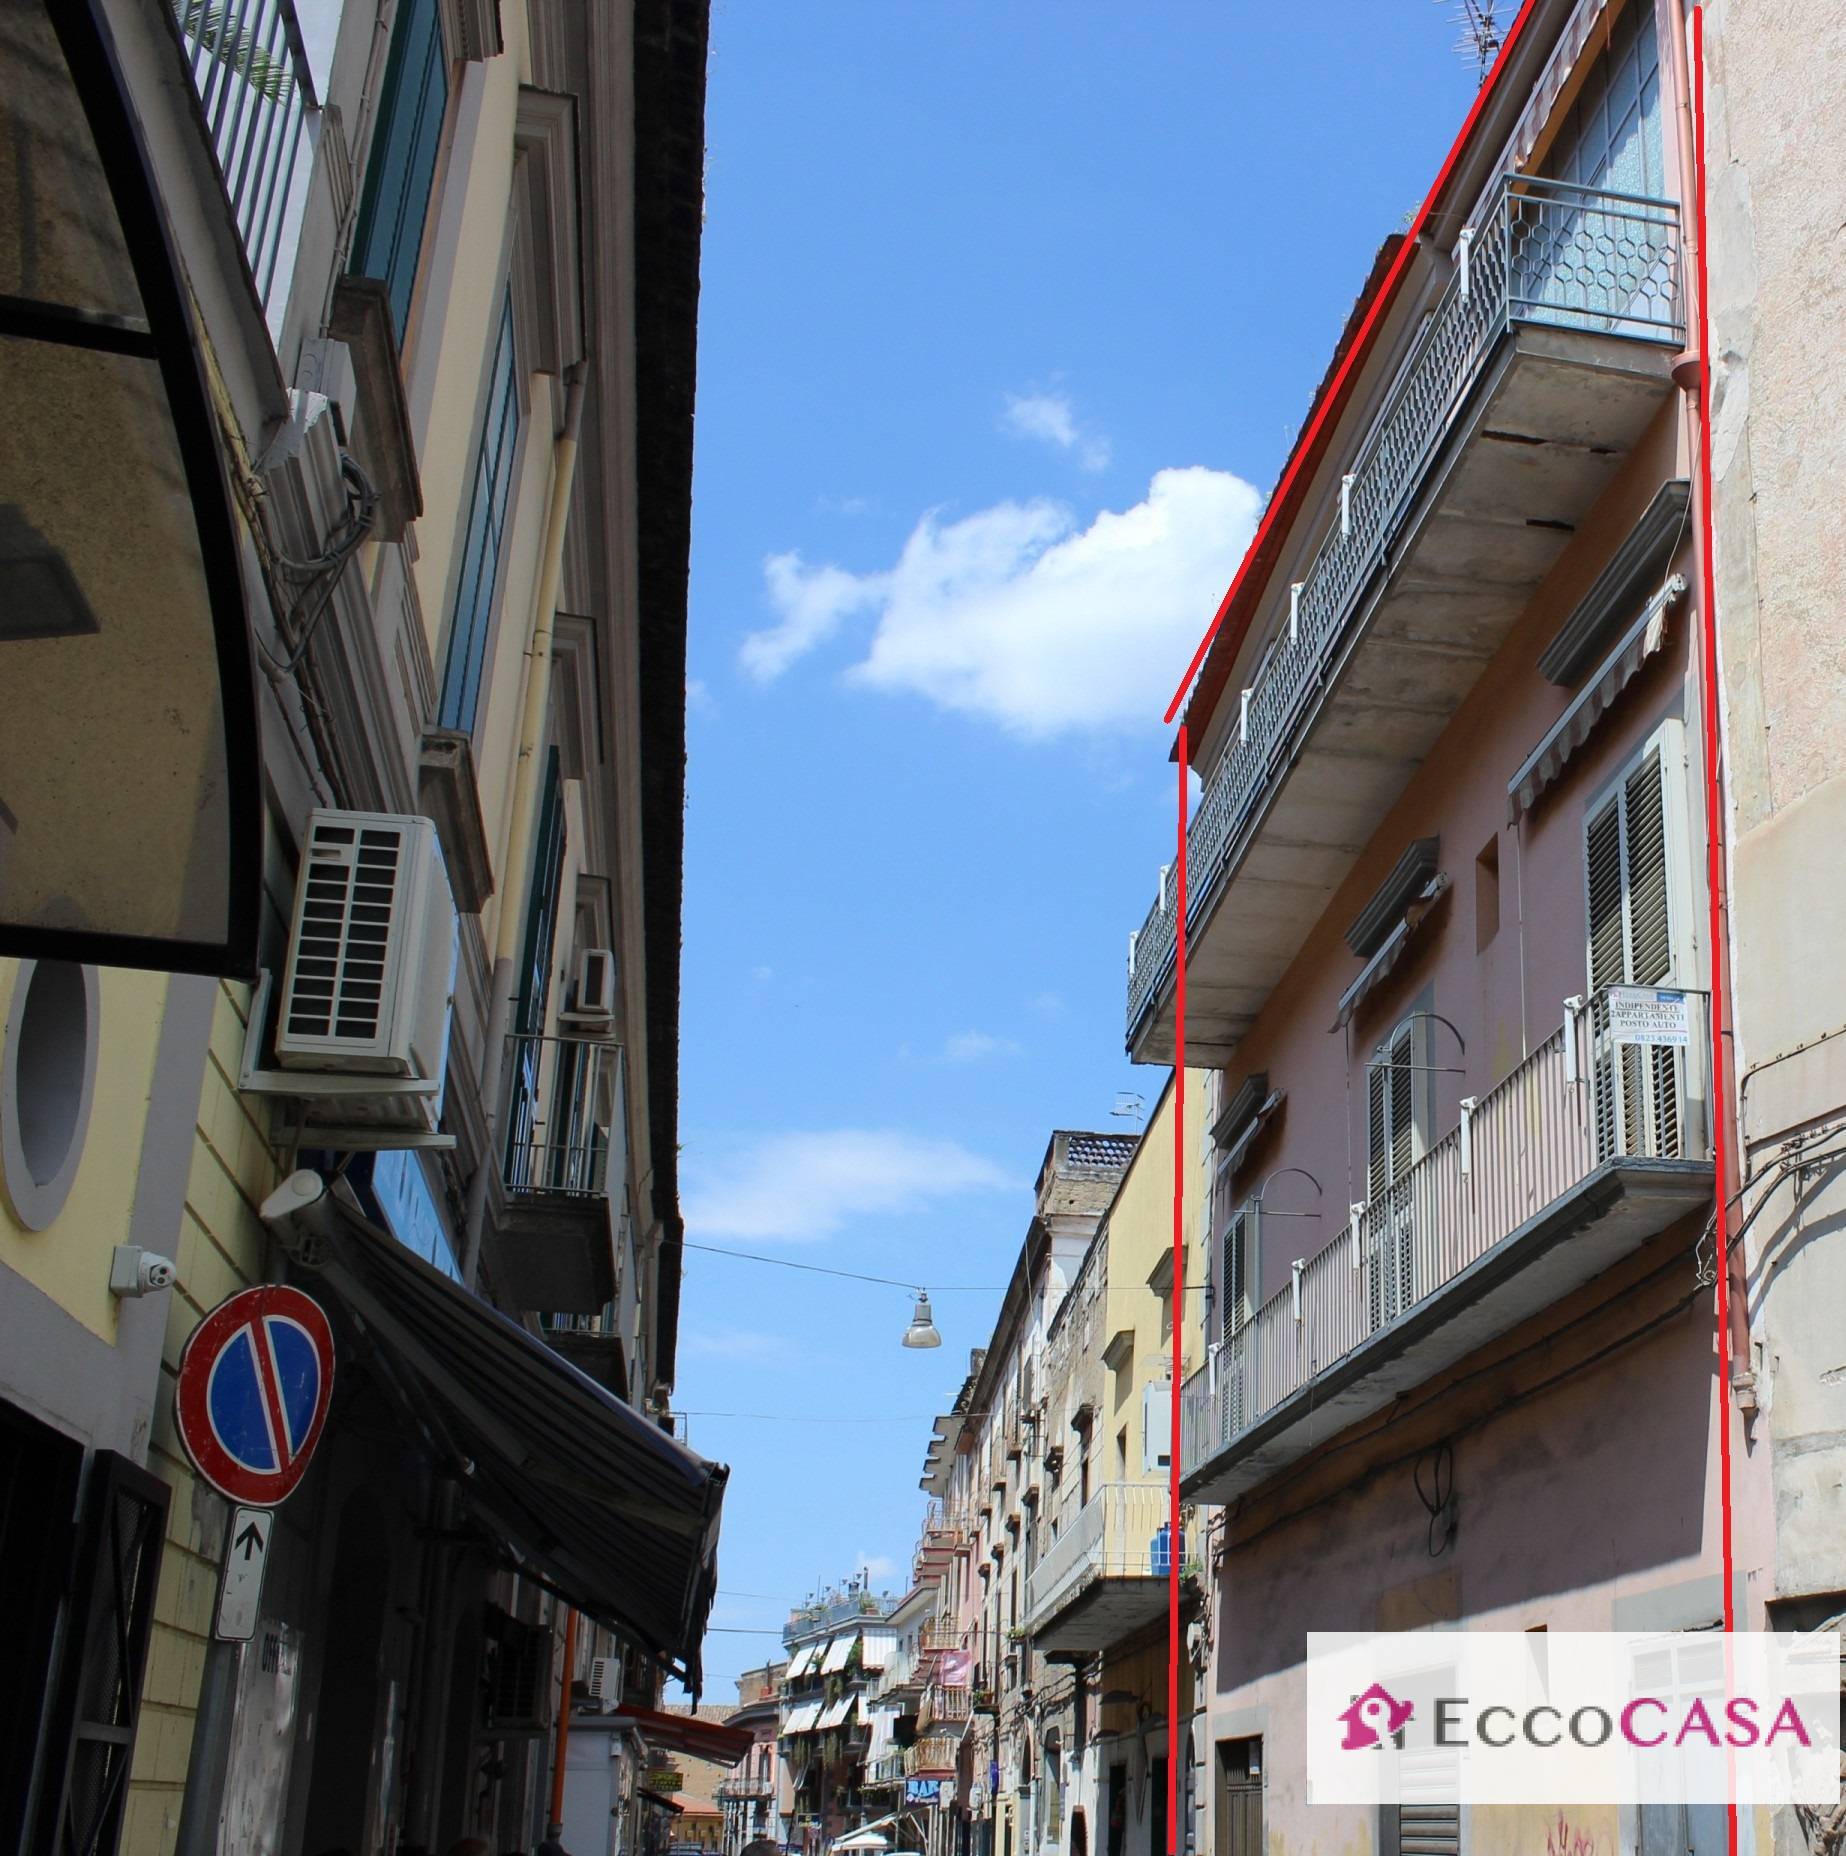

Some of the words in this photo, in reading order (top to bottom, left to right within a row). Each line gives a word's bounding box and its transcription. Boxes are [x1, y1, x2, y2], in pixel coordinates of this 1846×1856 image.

[1615, 1001, 1678, 1012] INDIPENDENTE
[1620, 1020, 1649, 1028] POSTO
[1652, 1021, 1676, 1029] AUTO
